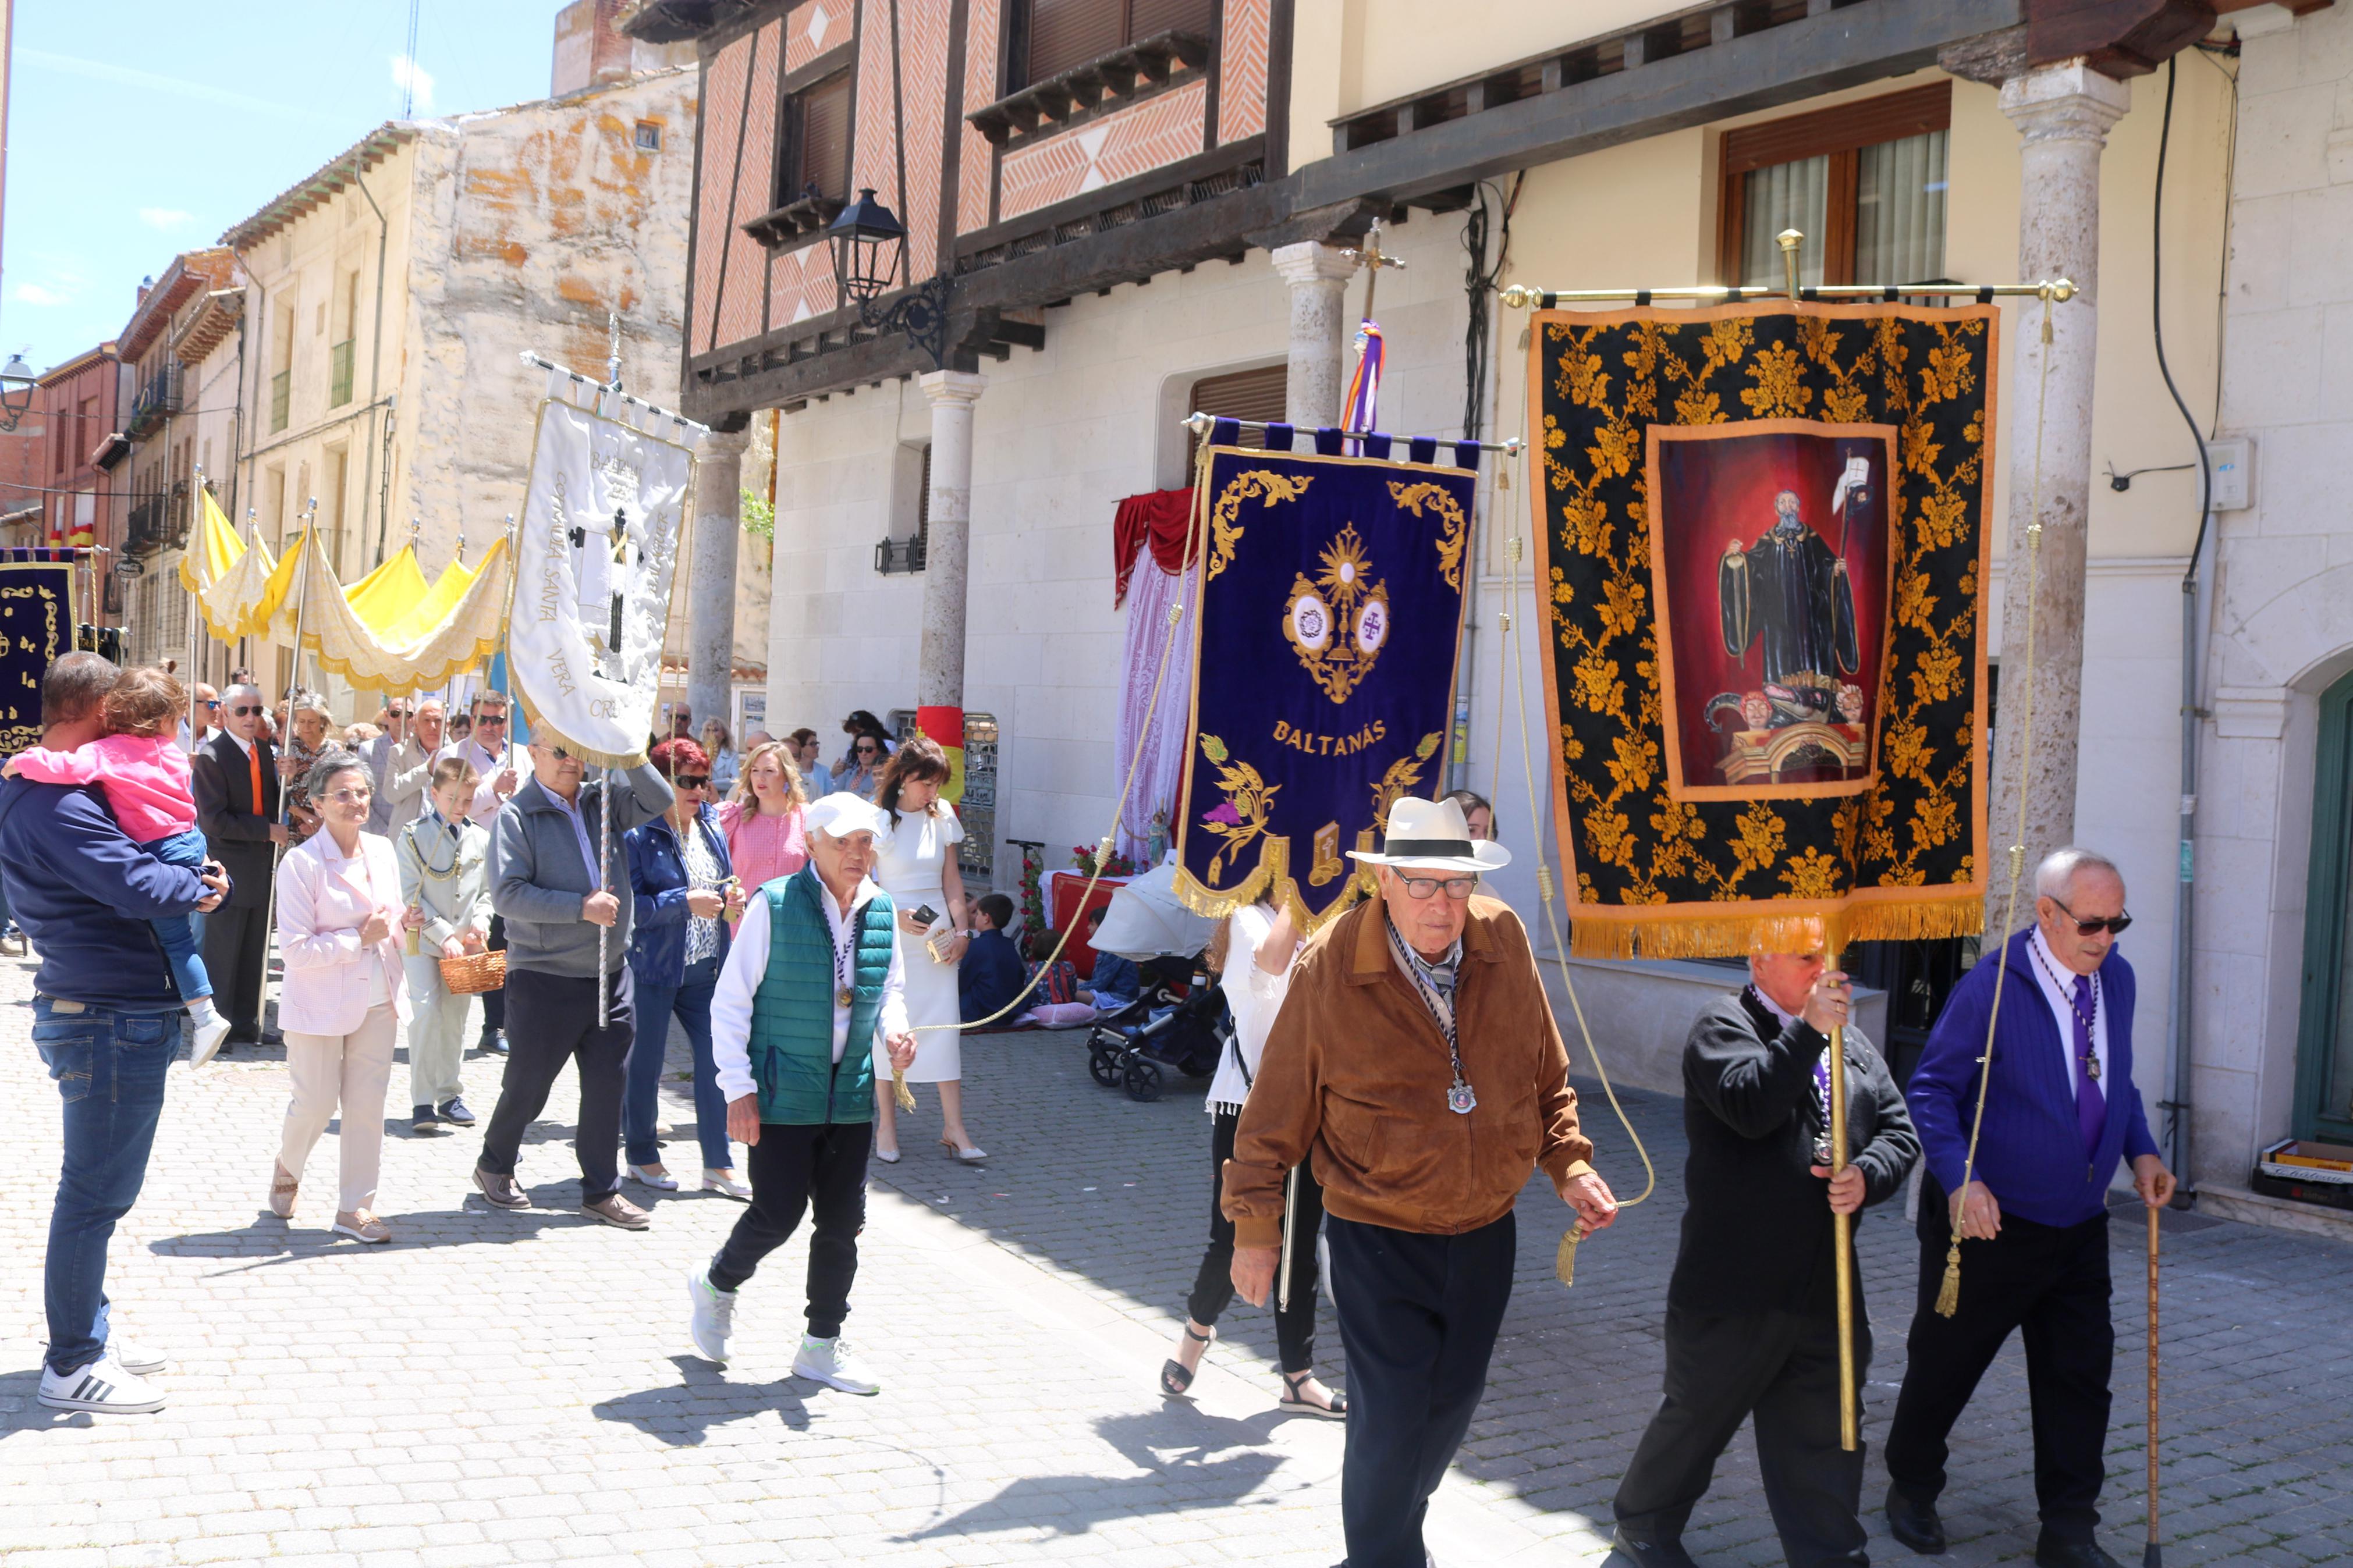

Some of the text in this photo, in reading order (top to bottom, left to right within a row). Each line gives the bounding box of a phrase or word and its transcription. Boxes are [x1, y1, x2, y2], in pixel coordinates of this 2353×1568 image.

[539, 568, 560, 622] SANTA
[546, 648, 576, 697] VERA
[1272, 720, 1386, 756] BALTANÁS
